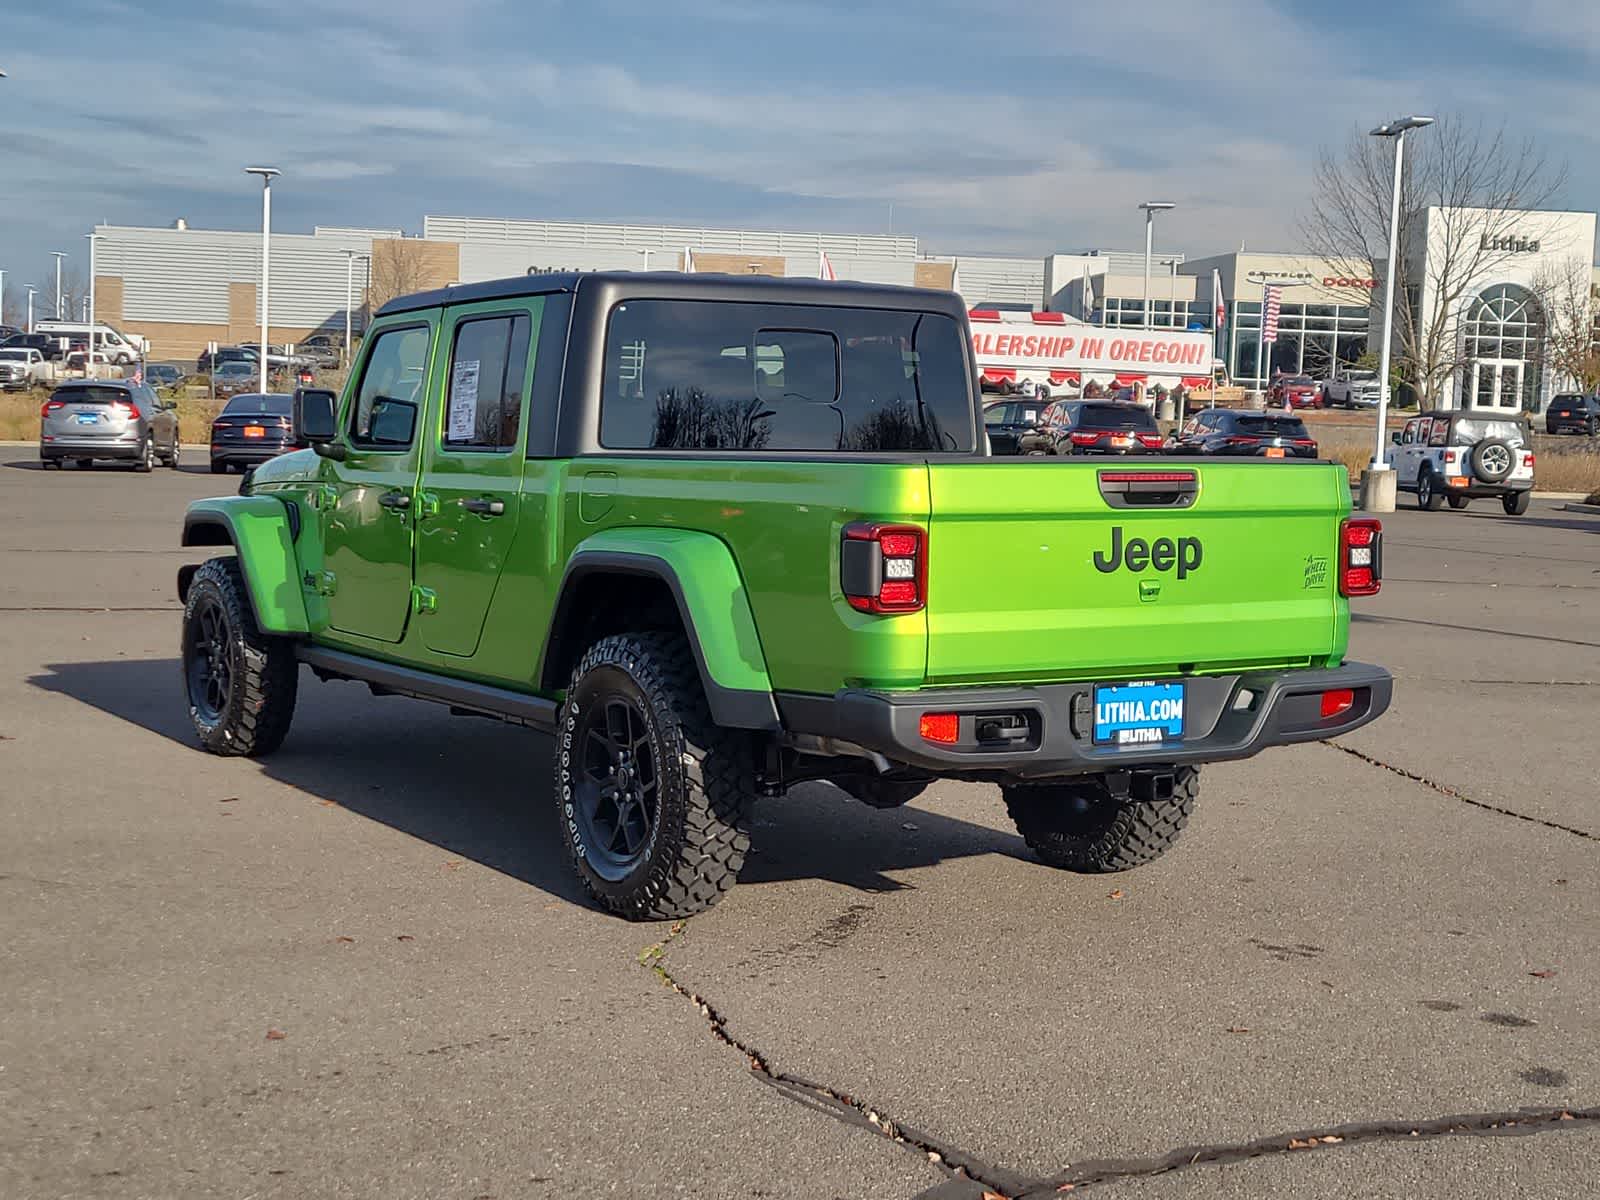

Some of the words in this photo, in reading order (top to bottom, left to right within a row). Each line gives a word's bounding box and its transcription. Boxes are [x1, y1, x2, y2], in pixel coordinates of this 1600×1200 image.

[1480, 234, 1540, 252] Lithia
[1323, 277, 1379, 288] DODG
[1080, 338, 1104, 359] IN
[1110, 339, 1207, 364] OREGON!
[1094, 527, 1203, 580] Jeep
[1304, 561, 1327, 576] WHEEL
[1096, 699, 1183, 724] LITHIA.COM
[1130, 728, 1162, 742] LITHIA
